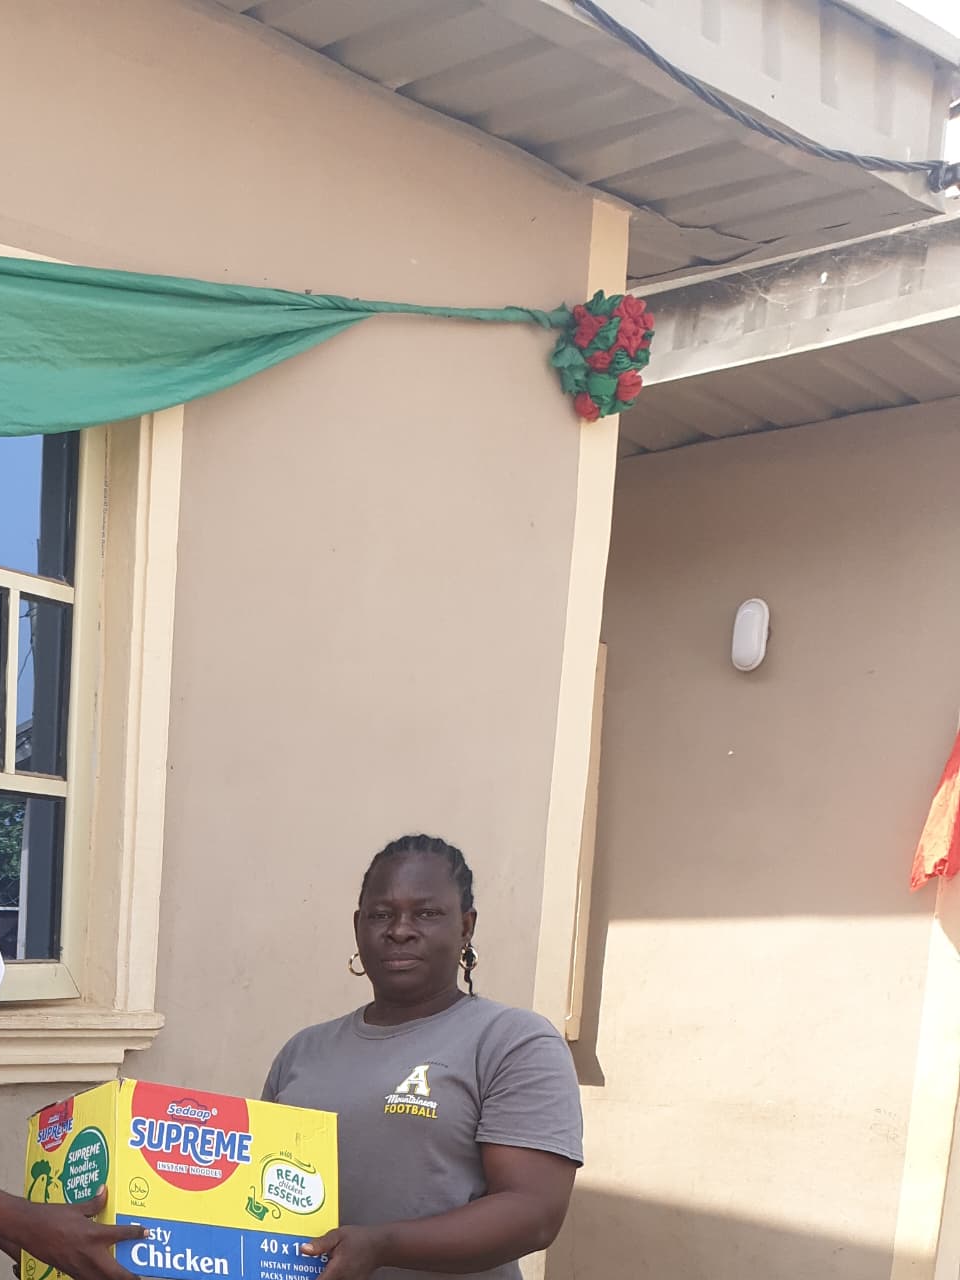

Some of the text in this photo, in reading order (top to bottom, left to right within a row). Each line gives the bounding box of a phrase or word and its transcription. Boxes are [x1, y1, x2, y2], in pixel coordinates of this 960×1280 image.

[394, 1064, 431, 1096] A
[167, 1103, 210, 1120] Sedaap
[384, 1104, 438, 1118] FOOTBALL
[129, 1117, 253, 1166] SUPREME
[68, 1142, 100, 1164] SUPREME
[70, 1160, 98, 1176] Noodles,
[156, 1162, 222, 1178] INSTANT NOODLES
[67, 1170, 100, 1190] SUPREME
[276, 1168, 306, 1190] REAL
[74, 1188, 91, 1200] Taste
[268, 1184, 313, 1208] ESSENCE
[278, 1180, 303, 1196] chicken
[260, 1238, 278, 1255] 40
[130, 1243, 230, 1276] Chicken
[260, 1260, 292, 1271] INSTANT
[260, 1272, 283, 1280] PACKS
